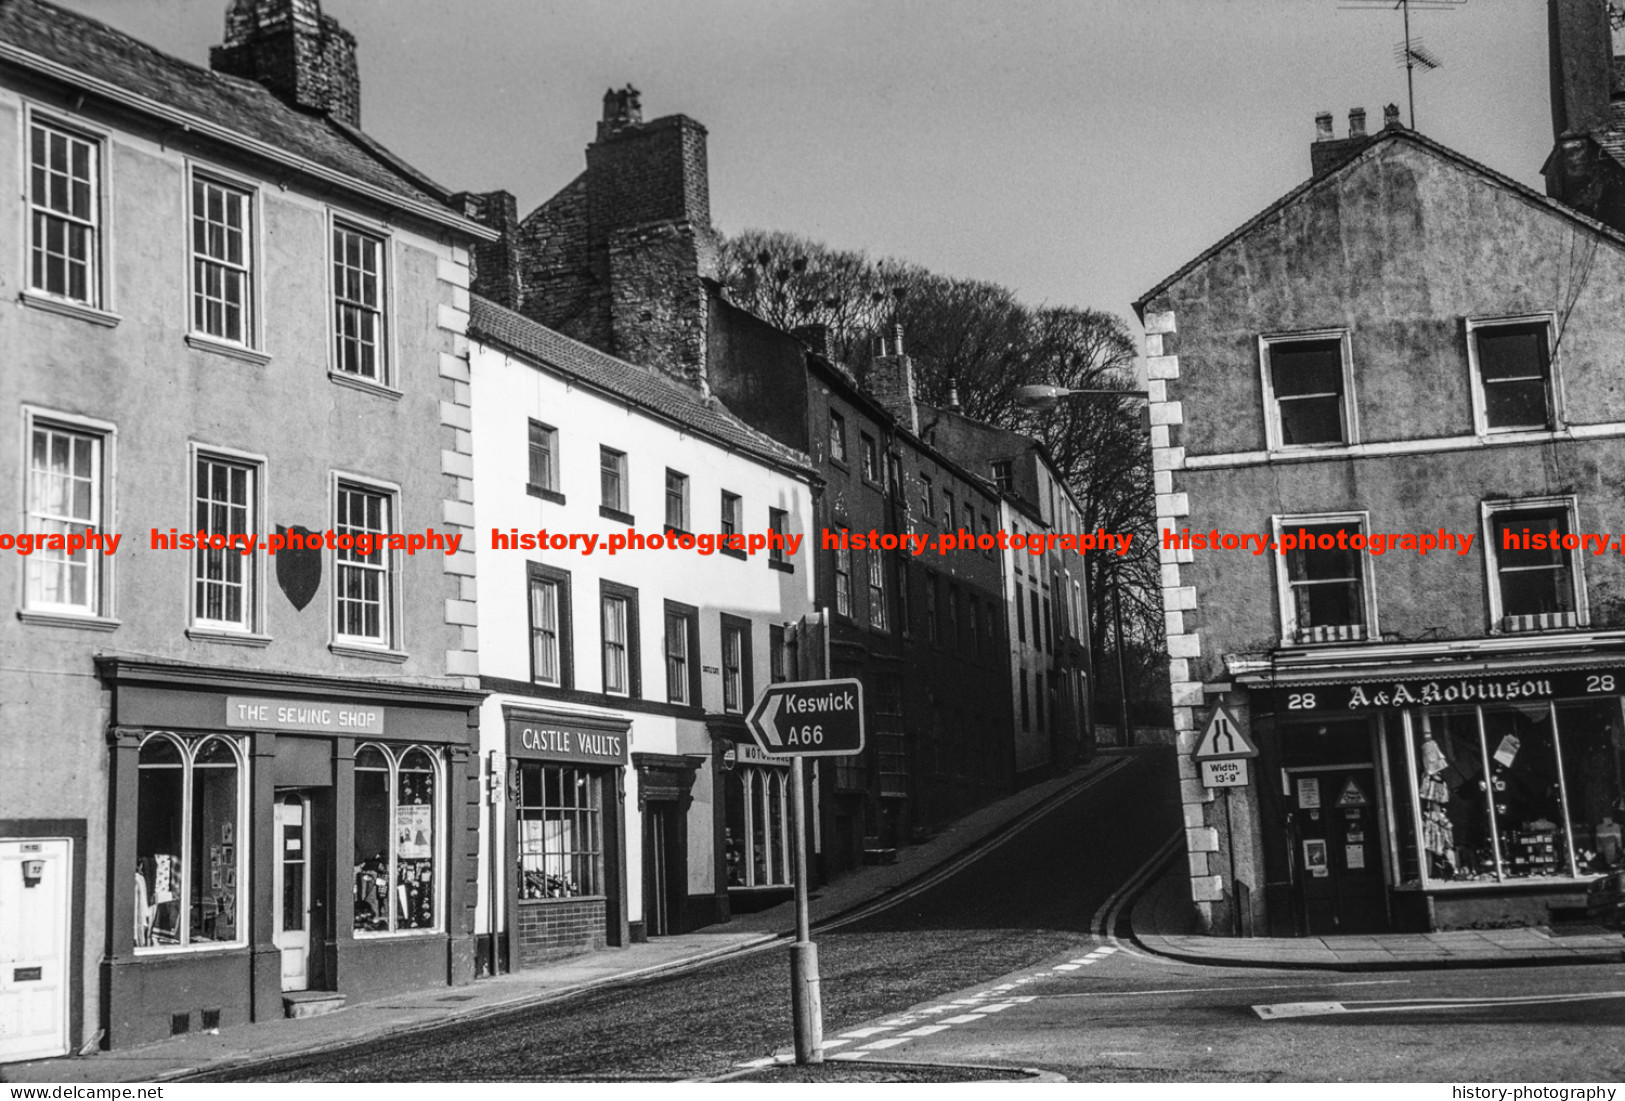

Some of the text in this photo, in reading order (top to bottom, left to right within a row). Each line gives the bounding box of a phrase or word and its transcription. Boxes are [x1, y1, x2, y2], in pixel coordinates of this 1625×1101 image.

[1586, 675, 1615, 692] 28
[785, 691, 854, 714] Keswick
[1288, 693, 1316, 709] 28
[238, 704, 376, 727] THE SEWING SHOP
[522, 728, 621, 756] CASTLE VAULTS
[787, 725, 823, 745] A66
[1210, 763, 1238, 772] Width
